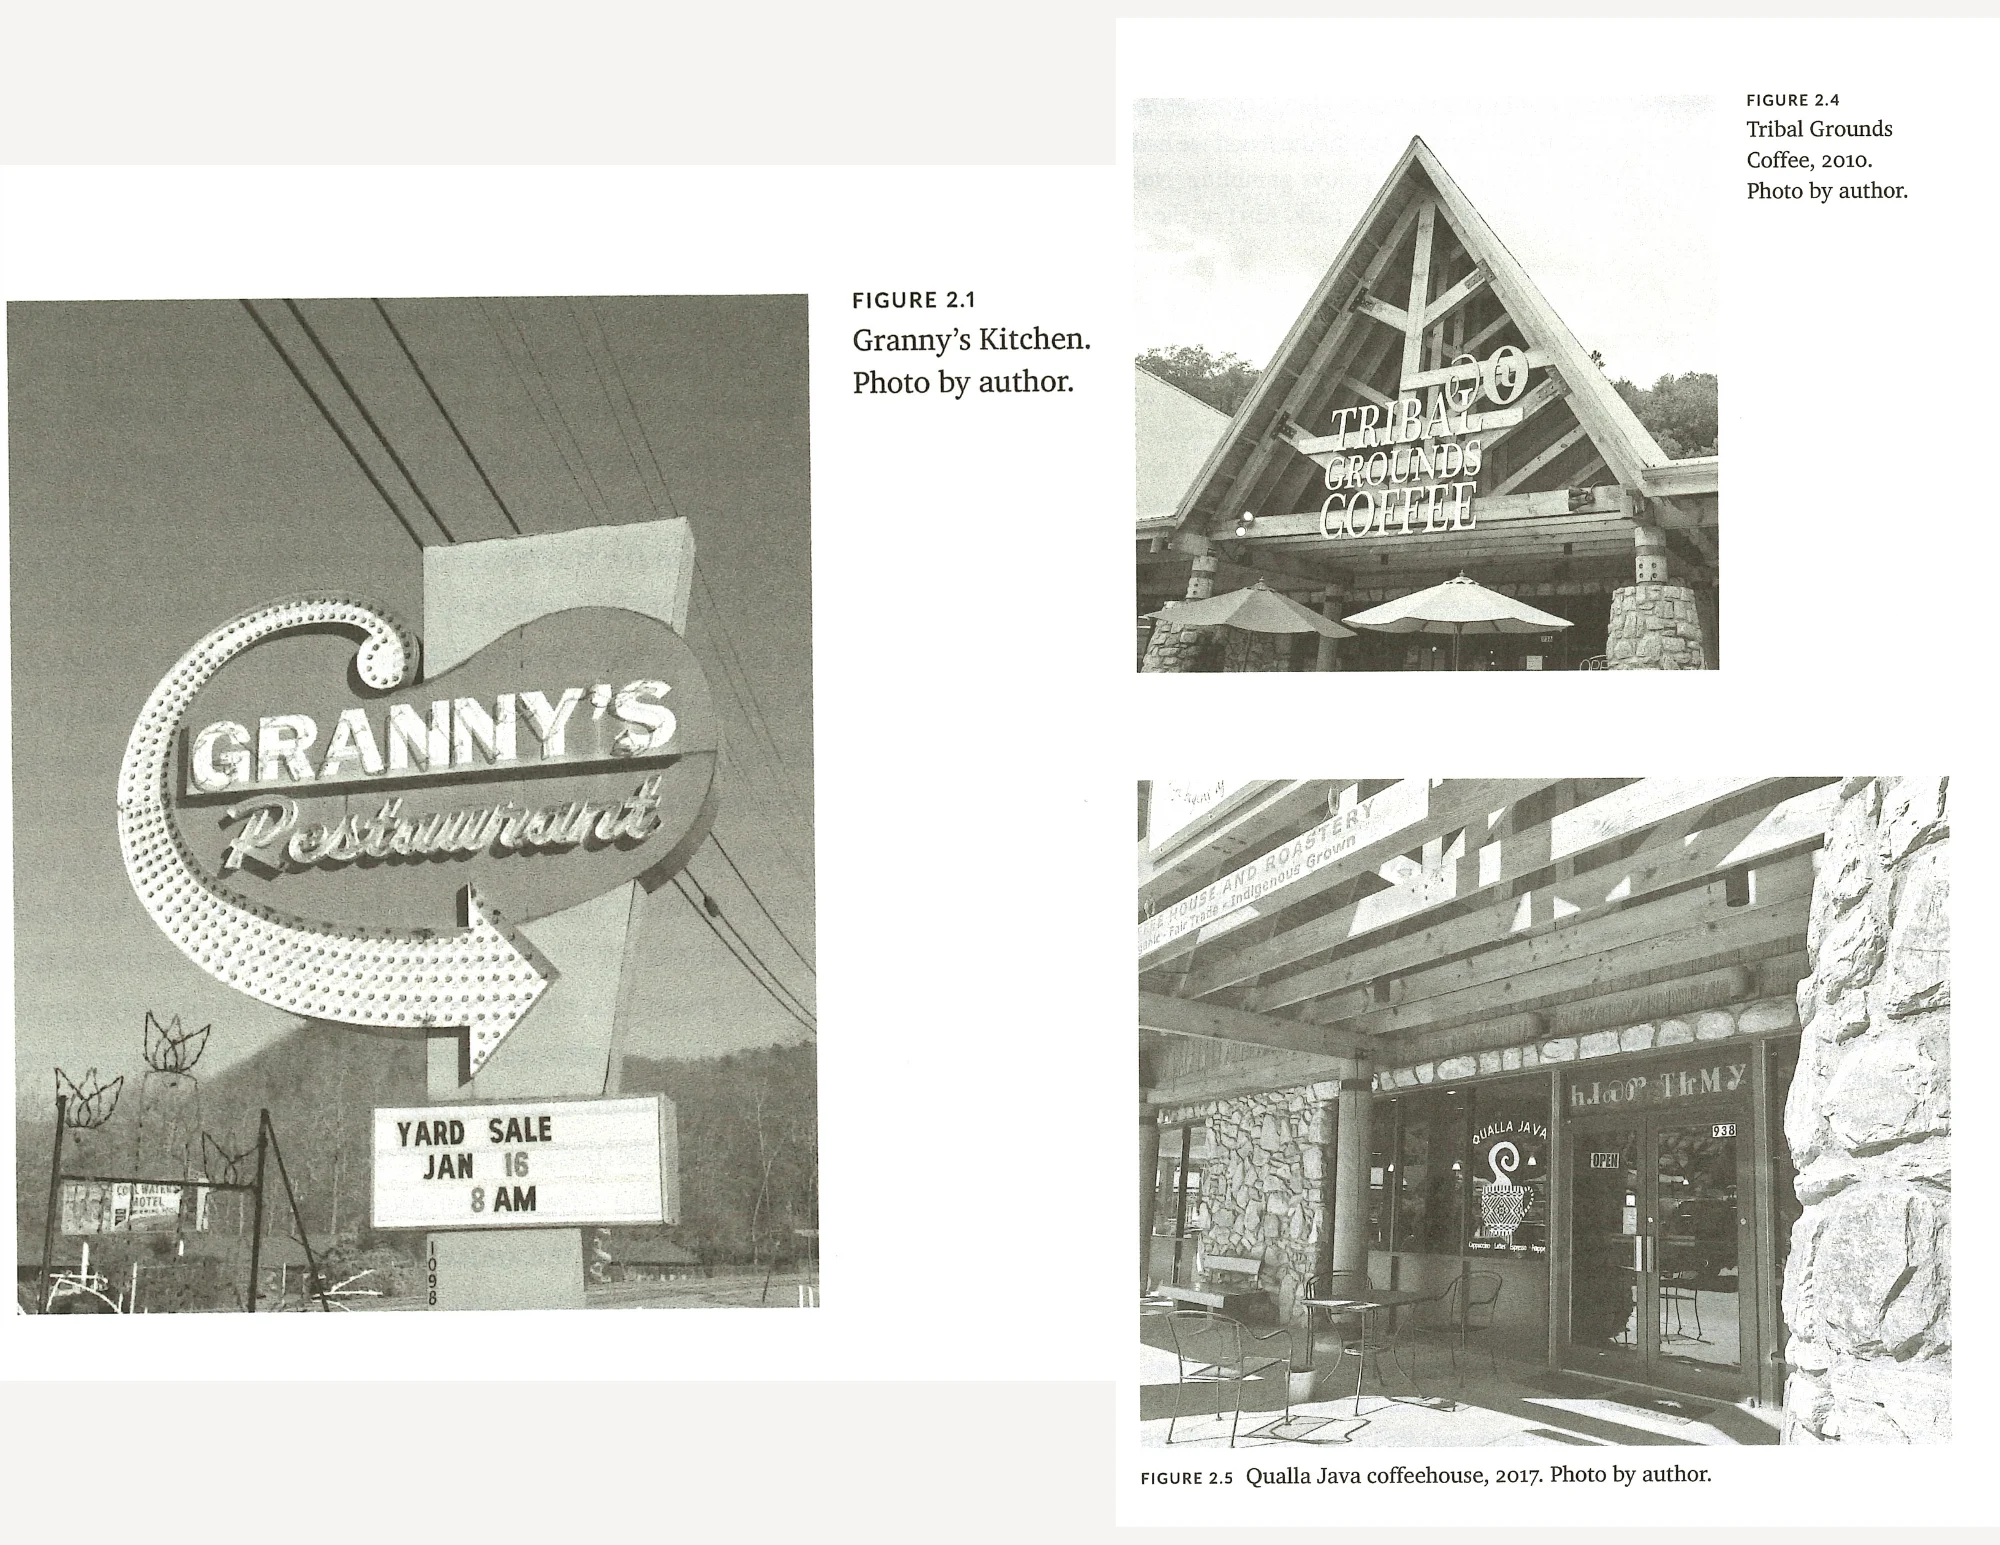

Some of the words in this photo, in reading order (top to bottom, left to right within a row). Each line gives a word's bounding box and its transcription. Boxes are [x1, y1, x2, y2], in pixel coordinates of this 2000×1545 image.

[1331, 388, 1484, 452] TRIBAL
[1324, 440, 1482, 491] GROUNDS
[1319, 481, 1478, 540] COFFEE
[190, 678, 679, 794] GRANNY'S
[218, 774, 663, 872] Restaurant
[1169, 885, 1217, 924] HOUSE
[1222, 866, 1257, 894] AND
[1265, 798, 1375, 872] ROASTERY
[1169, 920, 1188, 937] Fair
[1190, 904, 1219, 928] Trade
[1230, 864, 1301, 904] Indigenous
[1306, 834, 1357, 868] Grown
[398, 1120, 465, 1147] YARD
[489, 1116, 552, 1143] SALE
[1472, 1120, 1513, 1145] QUALLA
[1518, 1120, 1547, 1140] JAVA
[1713, 1124, 1735, 1137] 938
[423, 1153, 473, 1179] JAN
[504, 1152, 530, 1177] 16
[1592, 1153, 1618, 1167] OPEN
[116, 1184, 139, 1196] COL
[471, 1187, 485, 1213] 8
[494, 1185, 537, 1212] AM
[427, 1241, 438, 1307] 1098
